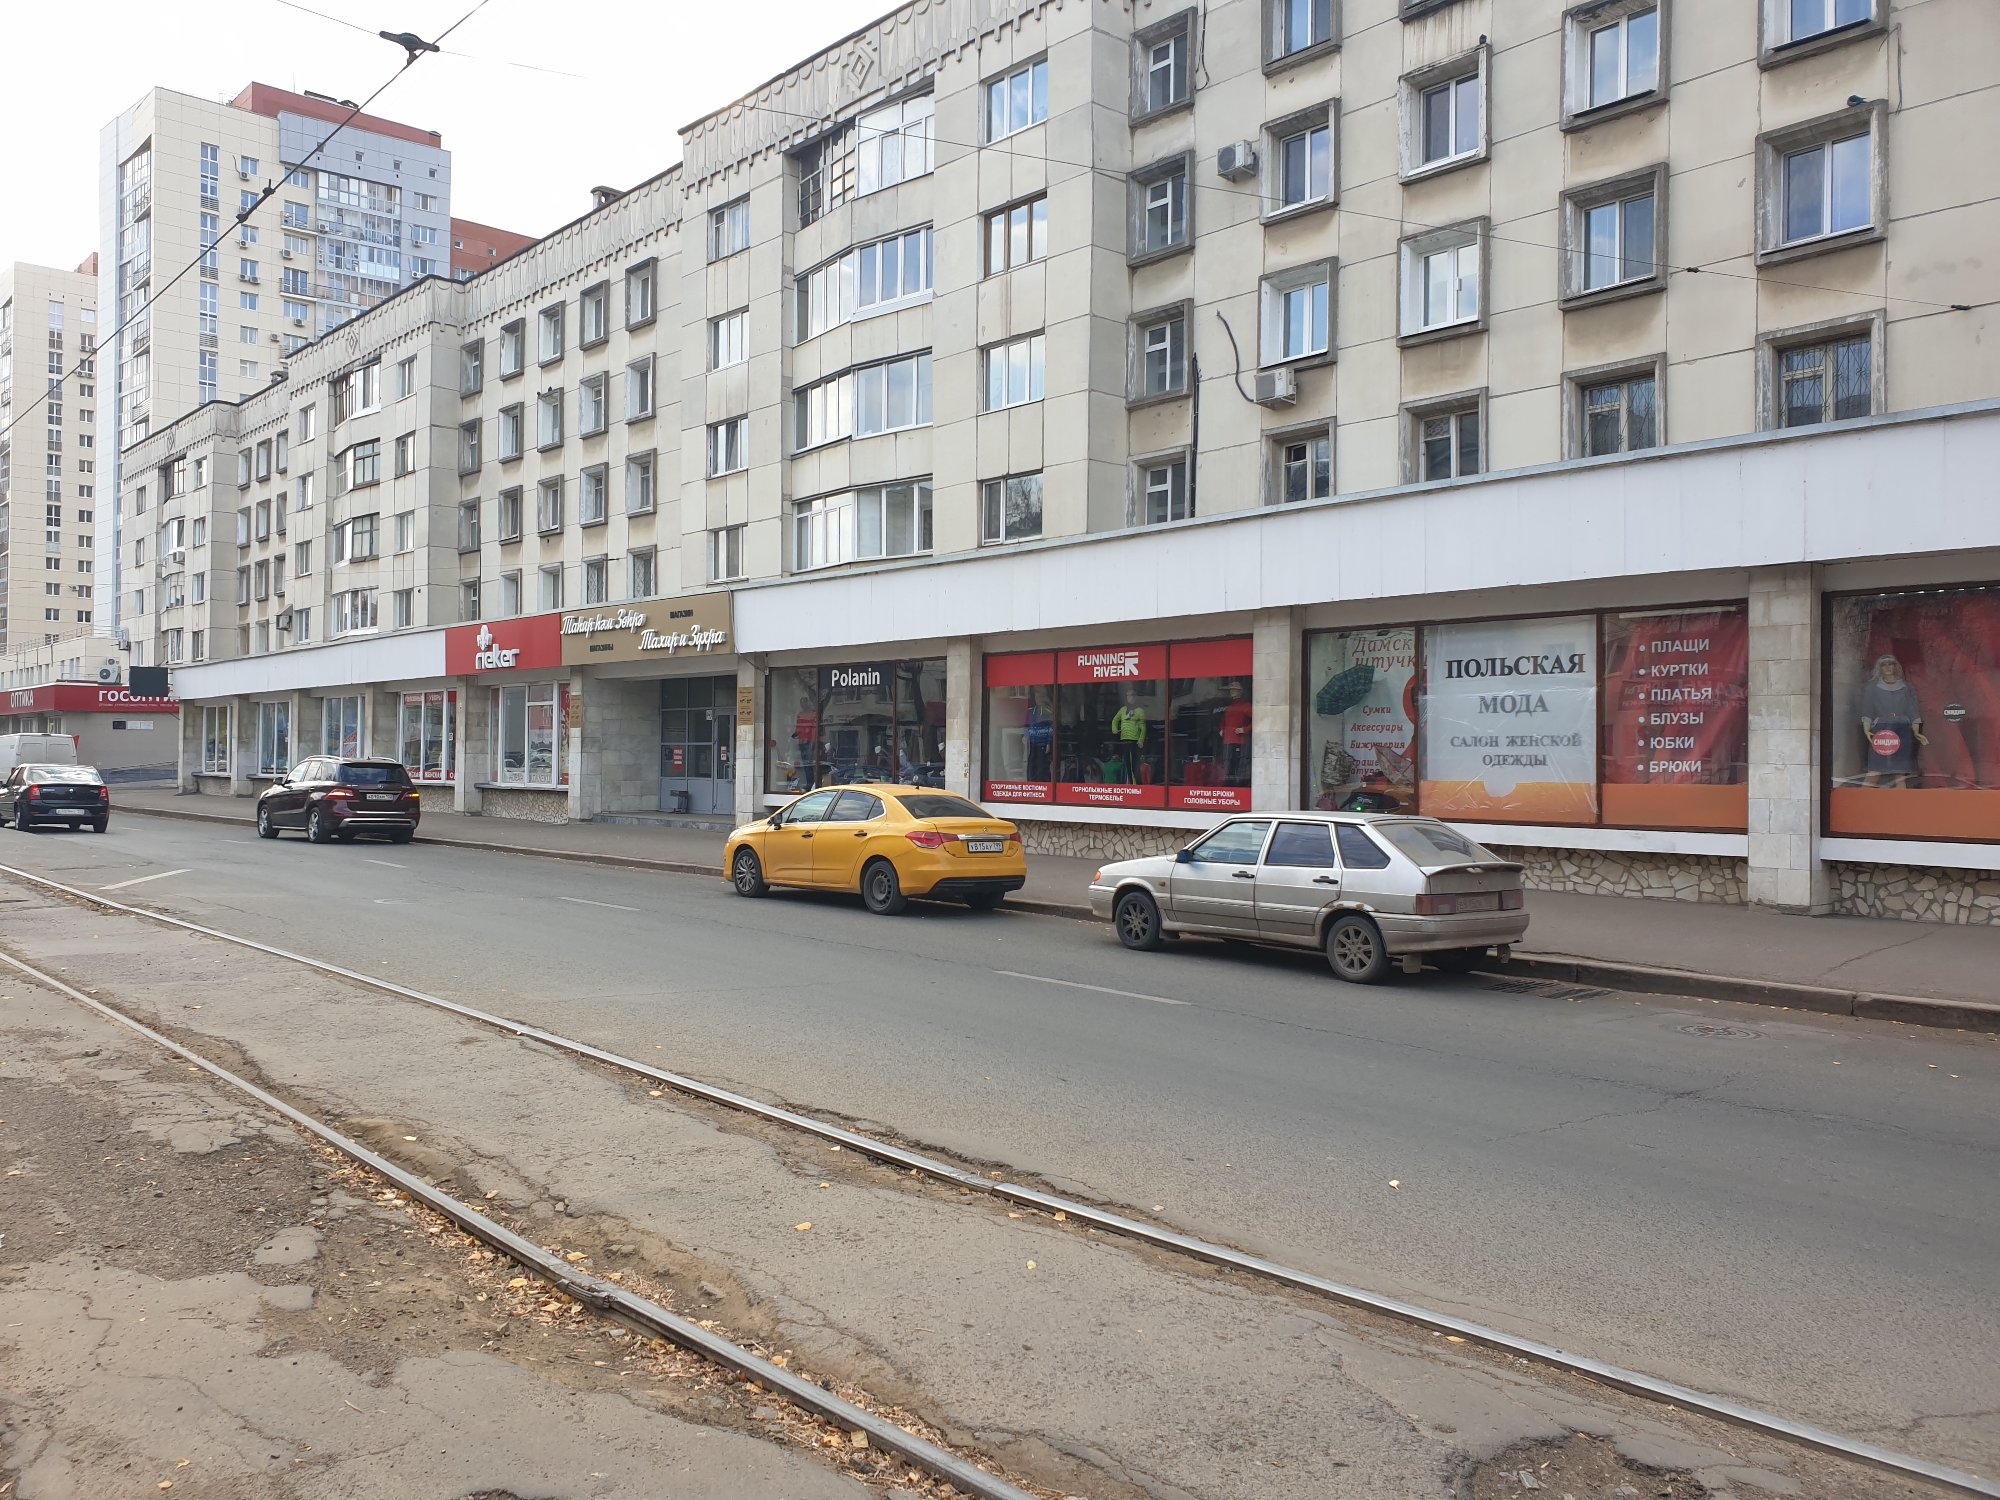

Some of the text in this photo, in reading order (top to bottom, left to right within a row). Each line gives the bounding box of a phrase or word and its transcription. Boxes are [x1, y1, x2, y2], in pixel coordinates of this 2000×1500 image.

[638, 624, 726, 654] Тахир и Зухра
[1651, 639, 1710, 654] ПЛАЩИ
[476, 644, 520, 670] rieker
[1077, 652, 1125, 666] RUNNING
[1093, 664, 1125, 678] RIVER
[1445, 653, 1586, 678] ПОЛЬСКАЯ
[1651, 663, 1708, 678] КУРТКИ
[831, 668, 880, 687] Polanin
[10, 690, 34, 708] ОПТИКА
[1651, 688, 1712, 700] ПЛАТЬЯ
[1362, 705, 1392, 716] Сумки
[1478, 694, 1549, 717] МОДА
[1650, 712, 1704, 726] БЛУЗЫ
[1350, 722, 1404, 733] Аксессуары
[1450, 732, 1582, 748] САЛОН ЖЕНСКОЙ
[1650, 736, 1694, 749] ЮБКИ
[1482, 754, 1548, 768] ОДЕЖДЫ
[1649, 760, 1702, 773] БРЮКИ
[1072, 786, 1113, 794] ГОРНОЛЫЖНЫЕ
[1212, 790, 1234, 798] БРЮКИ
[1089, 794, 1124, 802] ТЕРМОБЕЛЬЕ
[1218, 798, 1240, 806] УБОРЫ
